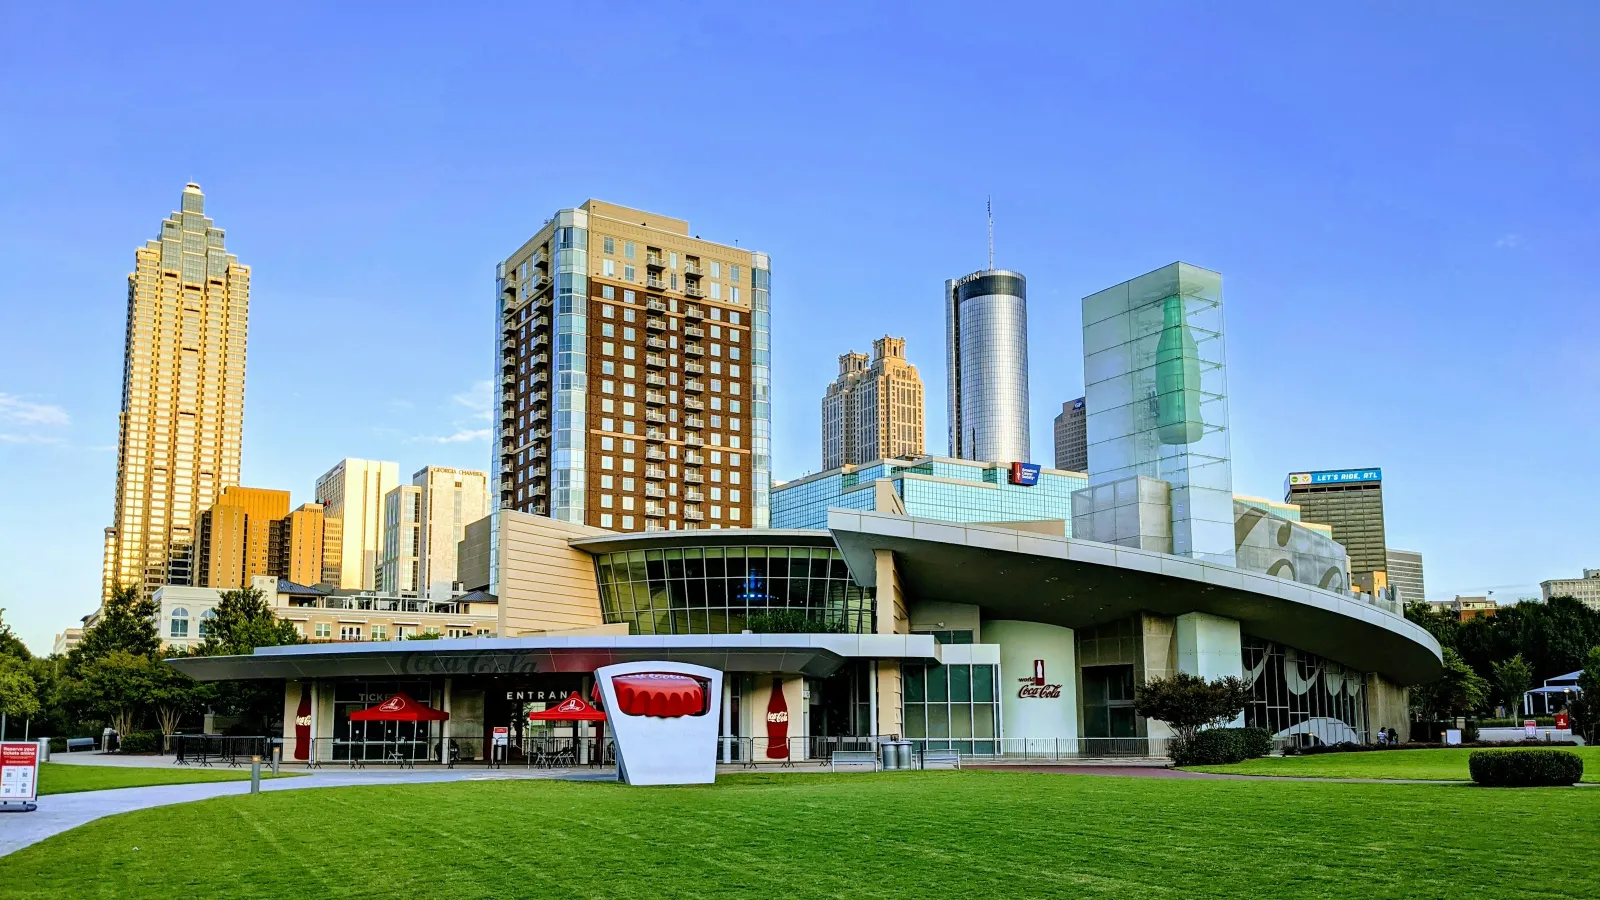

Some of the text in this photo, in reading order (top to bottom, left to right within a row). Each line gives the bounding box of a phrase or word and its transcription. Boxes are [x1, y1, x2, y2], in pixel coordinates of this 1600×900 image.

[506, 691, 568, 700] ENTRAN
[1018, 684, 1063, 699] Coca-Cola
[359, 693, 392, 702] TICKE
